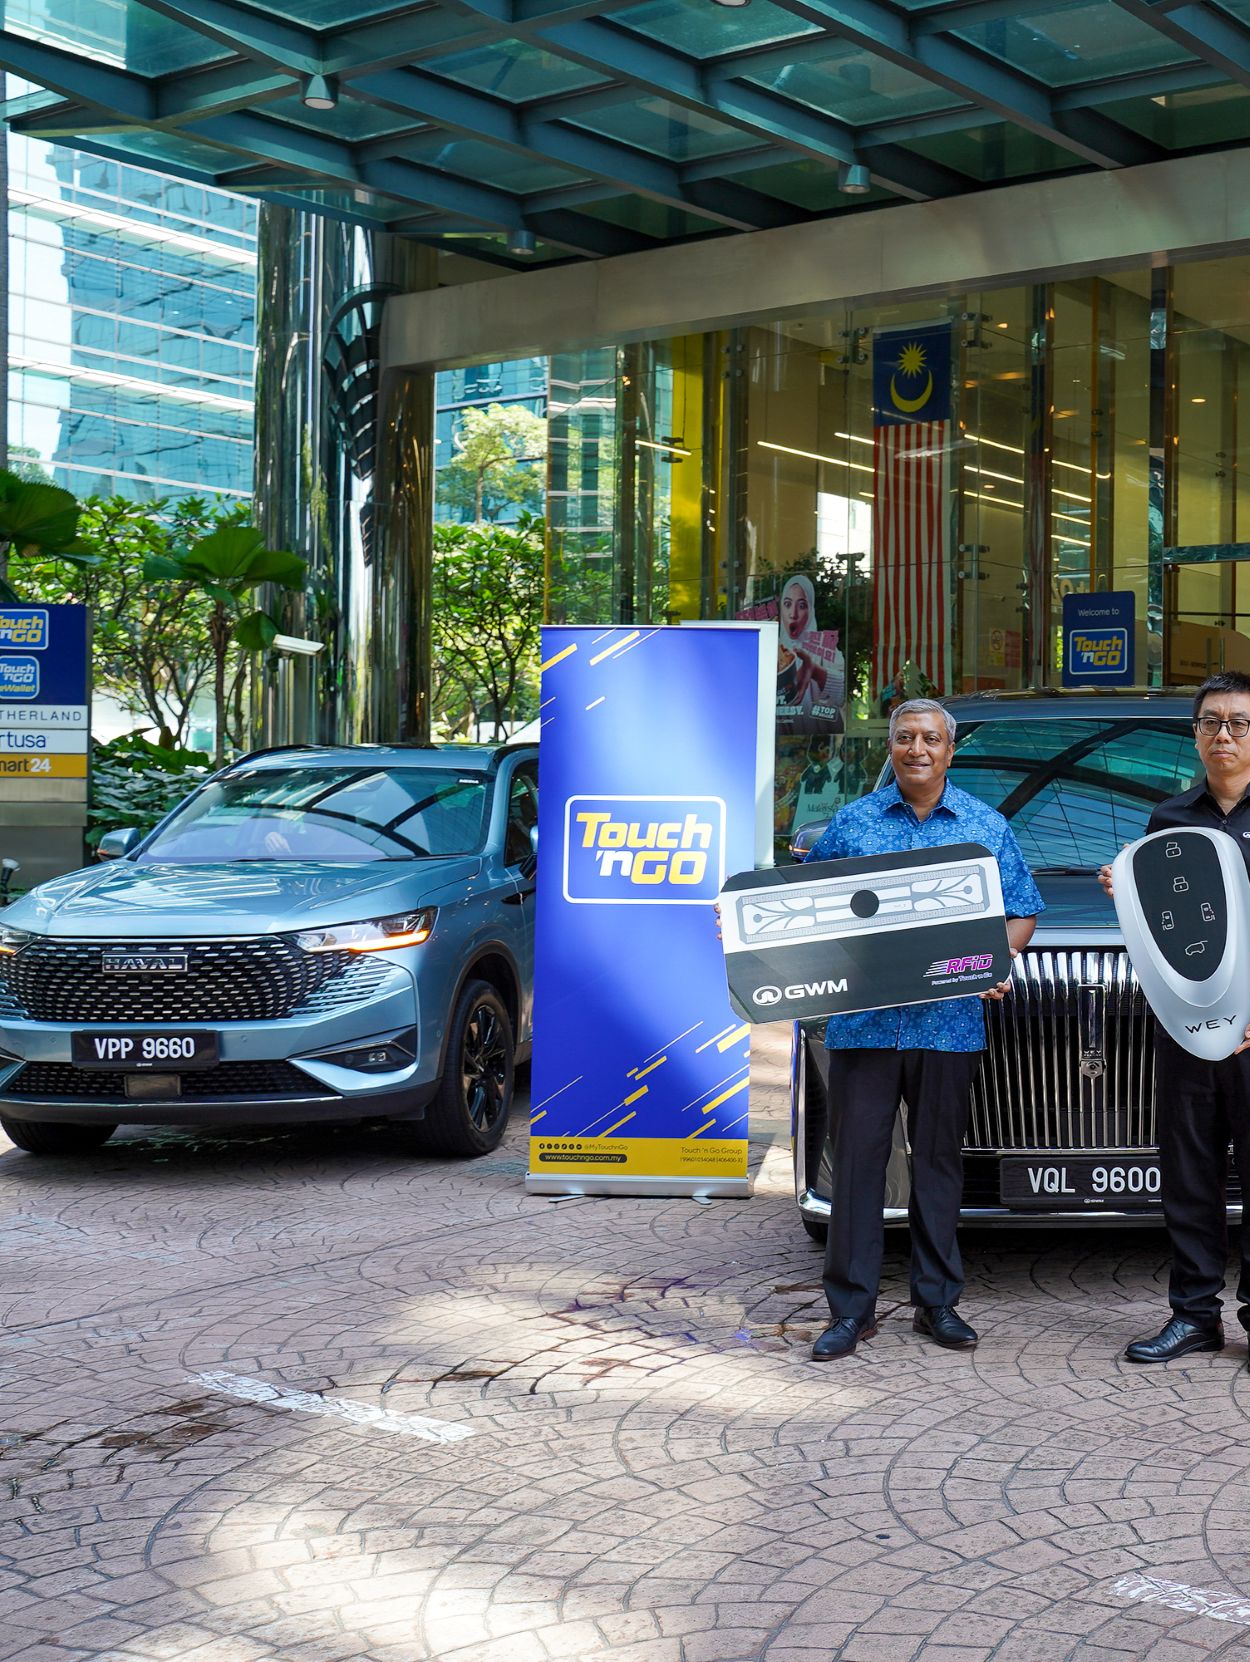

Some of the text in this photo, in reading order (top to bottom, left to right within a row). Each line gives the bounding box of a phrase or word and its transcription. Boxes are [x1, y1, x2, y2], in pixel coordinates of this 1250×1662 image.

[1077, 607, 1120, 617] Welcome to
[1074, 635, 1123, 652] Touch
[0, 663, 35, 673] Touch
[575, 812, 714, 848] Touch
[105, 958, 183, 969] HAVAL
[784, 978, 848, 1000] GWM
[1184, 1015, 1237, 1034] WEY
[94, 1037, 195, 1059] VPP 9660
[545, 1154, 622, 1162] www.touchngo.com.my
[721, 1147, 743, 1155] Group
[1027, 1166, 1161, 1193] VQL 9600
